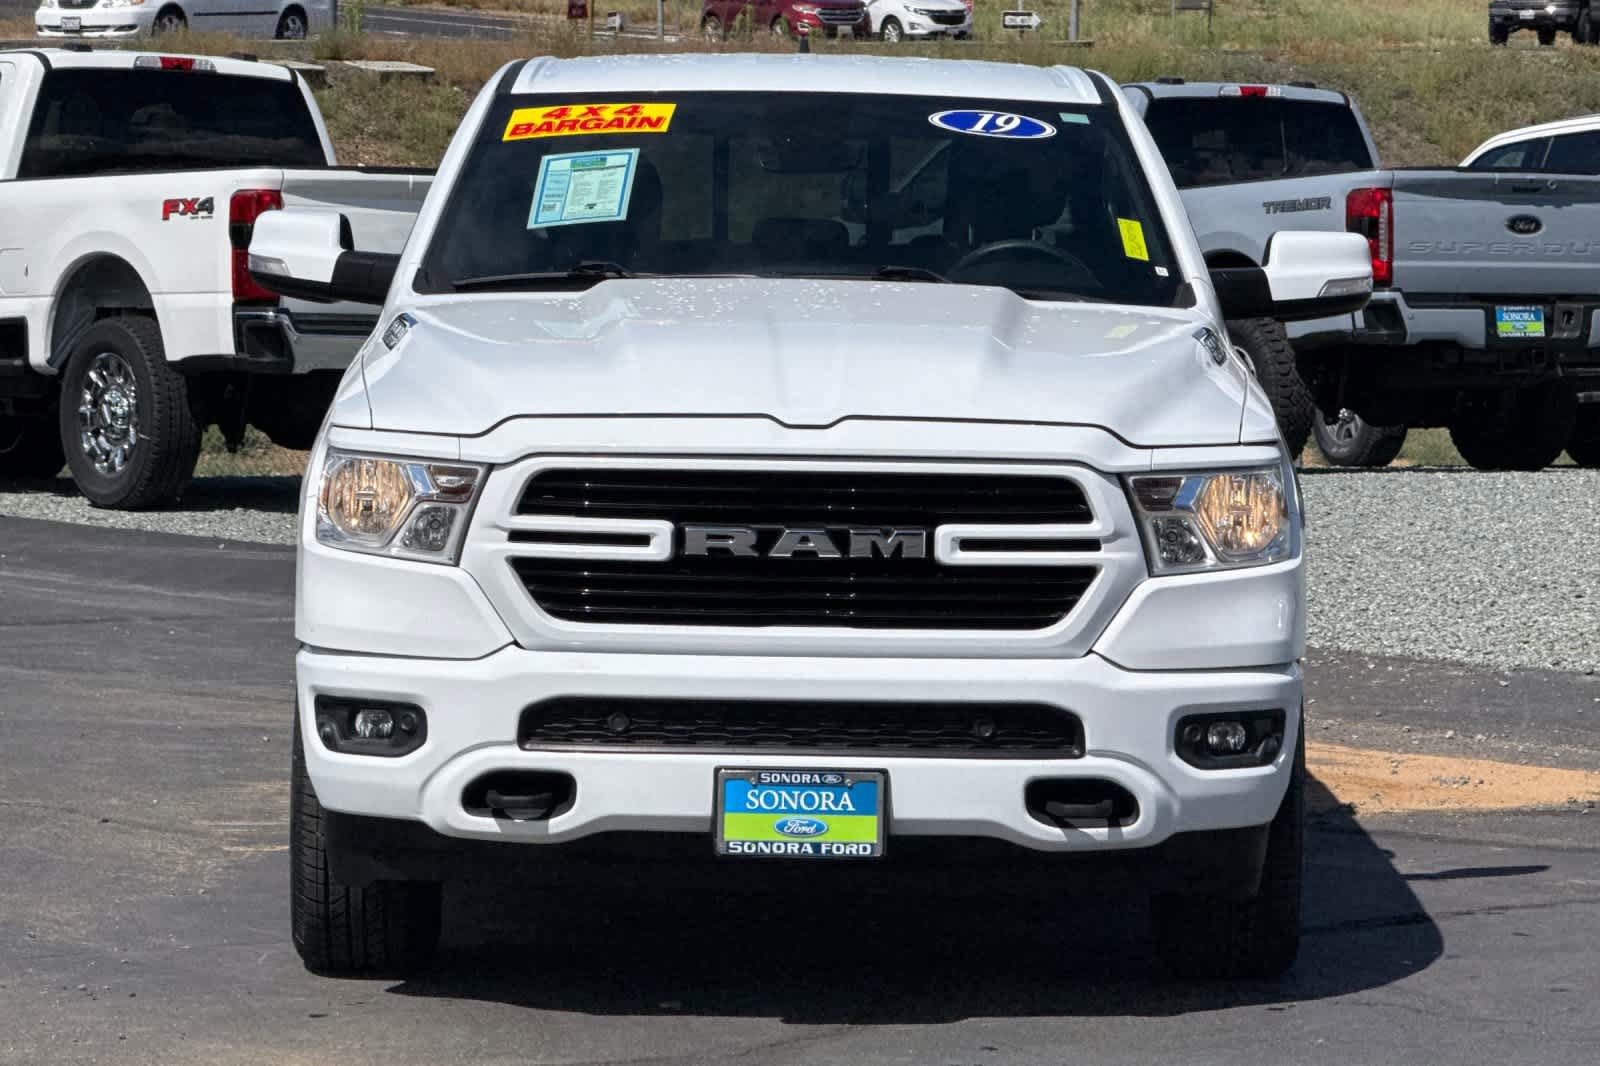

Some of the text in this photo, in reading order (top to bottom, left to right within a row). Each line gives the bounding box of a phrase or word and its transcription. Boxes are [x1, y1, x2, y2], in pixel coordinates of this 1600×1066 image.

[508, 116, 664, 136] BARGAIN
[966, 113, 1021, 133] 19
[162, 196, 214, 220] FX4
[1263, 196, 1332, 214] TREMOR
[1408, 240, 1537, 255] SUPER
[684, 526, 926, 558] RAM
[760, 772, 821, 784] SONORA
[745, 789, 856, 812] SONORA
[783, 820, 817, 835] Ford
[728, 841, 872, 855] SONORA FORD
